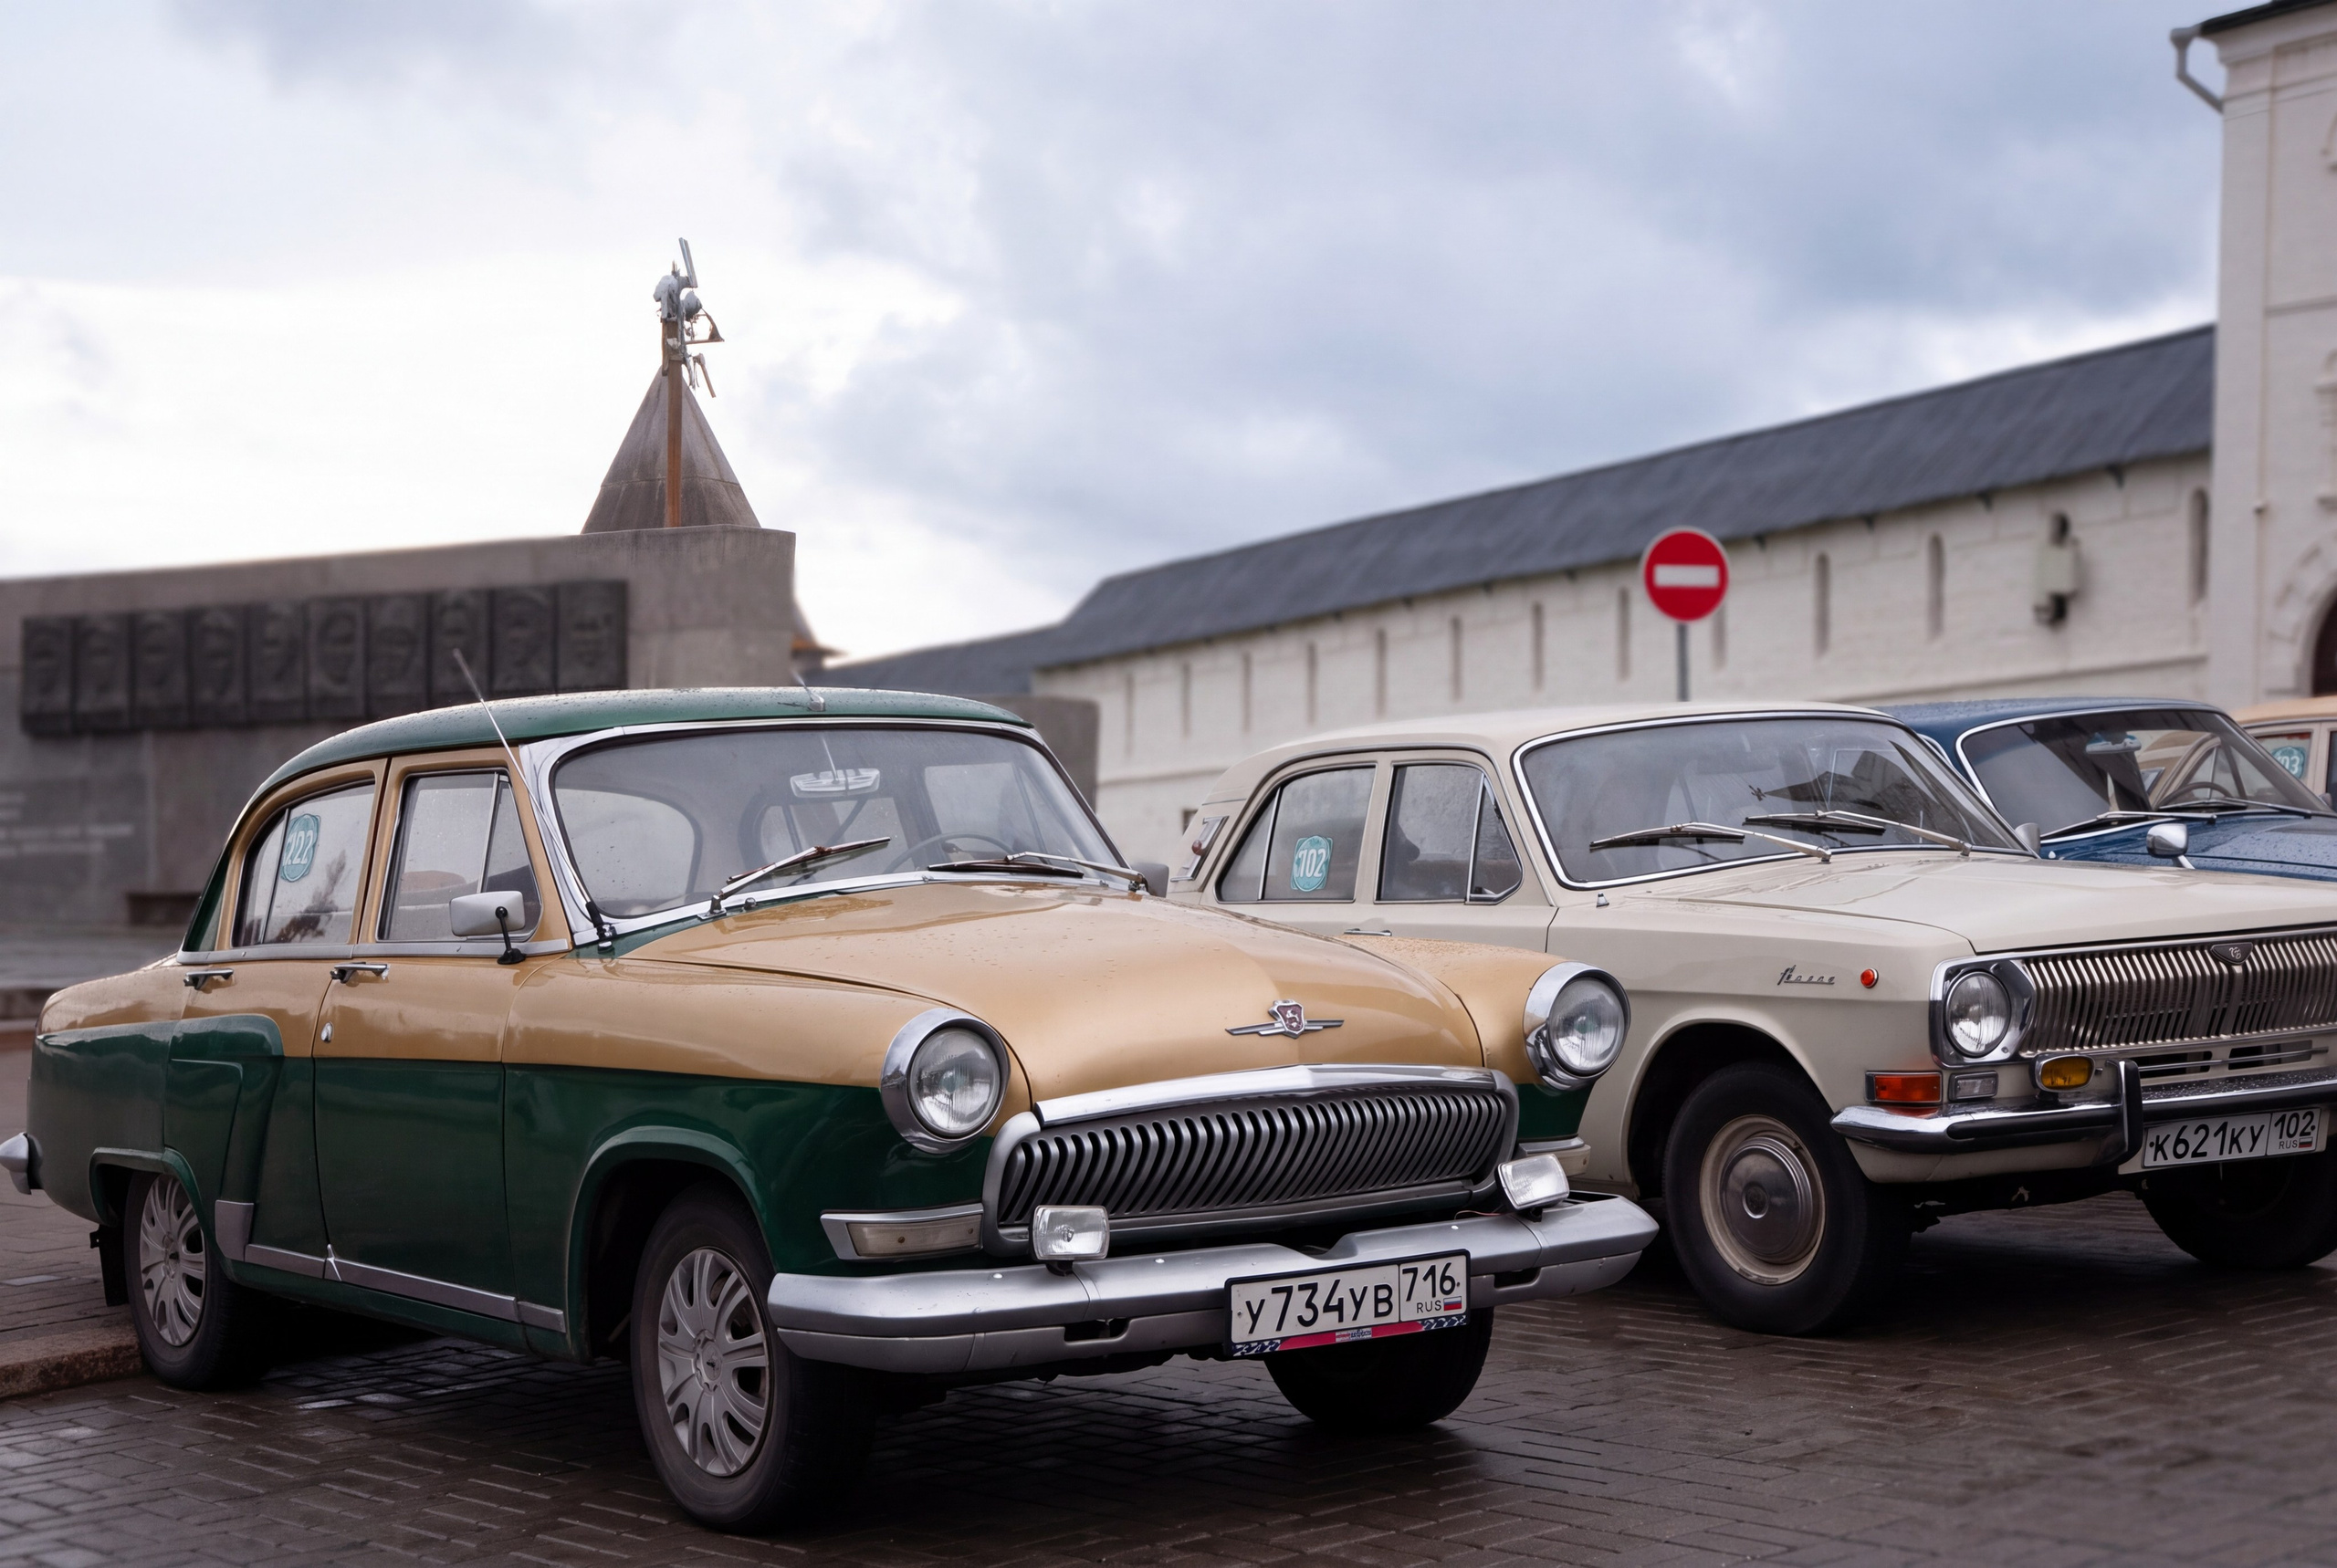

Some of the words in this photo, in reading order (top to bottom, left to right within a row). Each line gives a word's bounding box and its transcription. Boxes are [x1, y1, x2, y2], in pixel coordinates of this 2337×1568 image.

[2153, 1121, 2266, 1162] К621КУ
[2274, 1110, 2315, 1140] 102
[2278, 1139, 2299, 1150] RUS
[1245, 1279, 1394, 1334] У734УВ
[1401, 1261, 1456, 1302] 716
[1416, 1300, 1442, 1313] RUS
